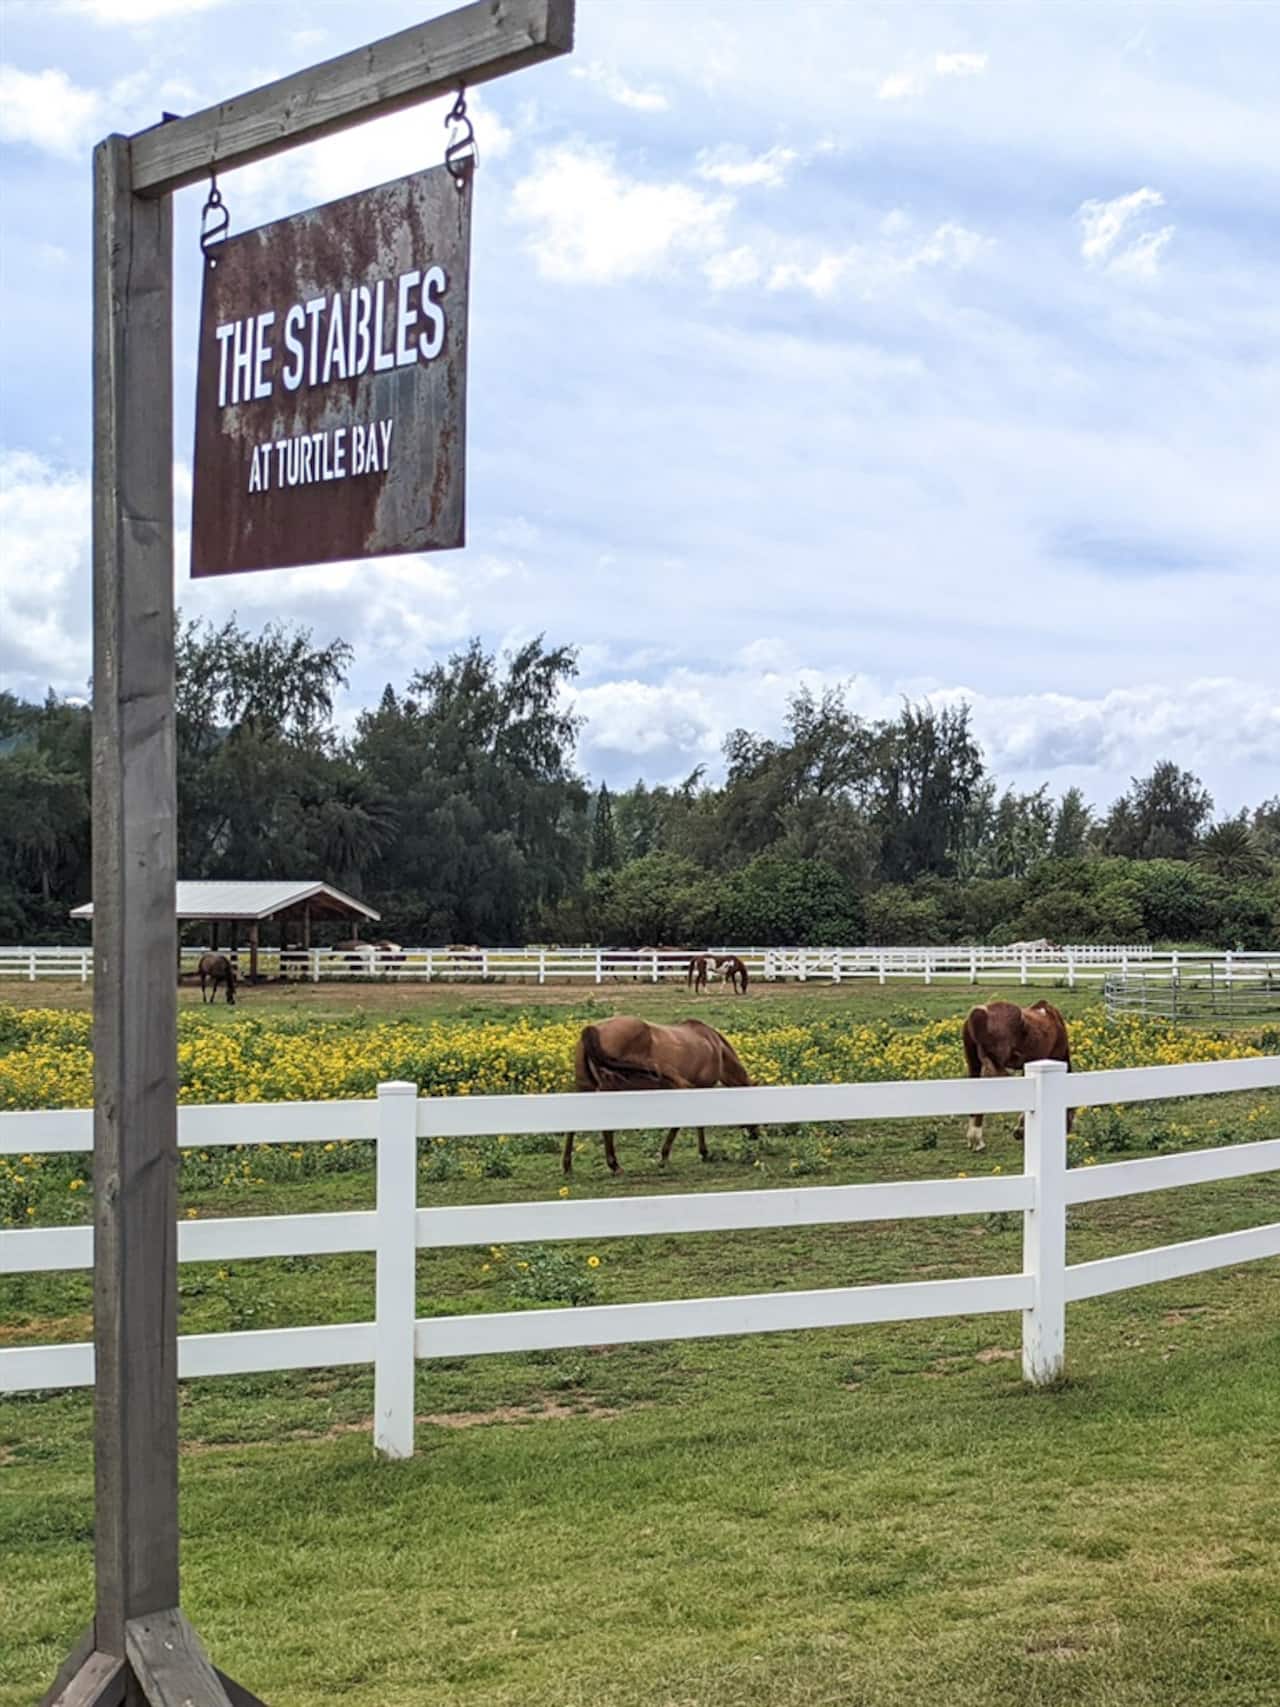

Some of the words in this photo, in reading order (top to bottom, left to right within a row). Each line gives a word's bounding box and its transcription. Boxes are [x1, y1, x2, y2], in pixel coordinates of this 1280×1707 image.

[216, 311, 275, 407] THE
[282, 265, 446, 391] STABLES
[248, 443, 272, 493] AT
[277, 427, 346, 488] TURTLE
[352, 419, 393, 474] BAY
